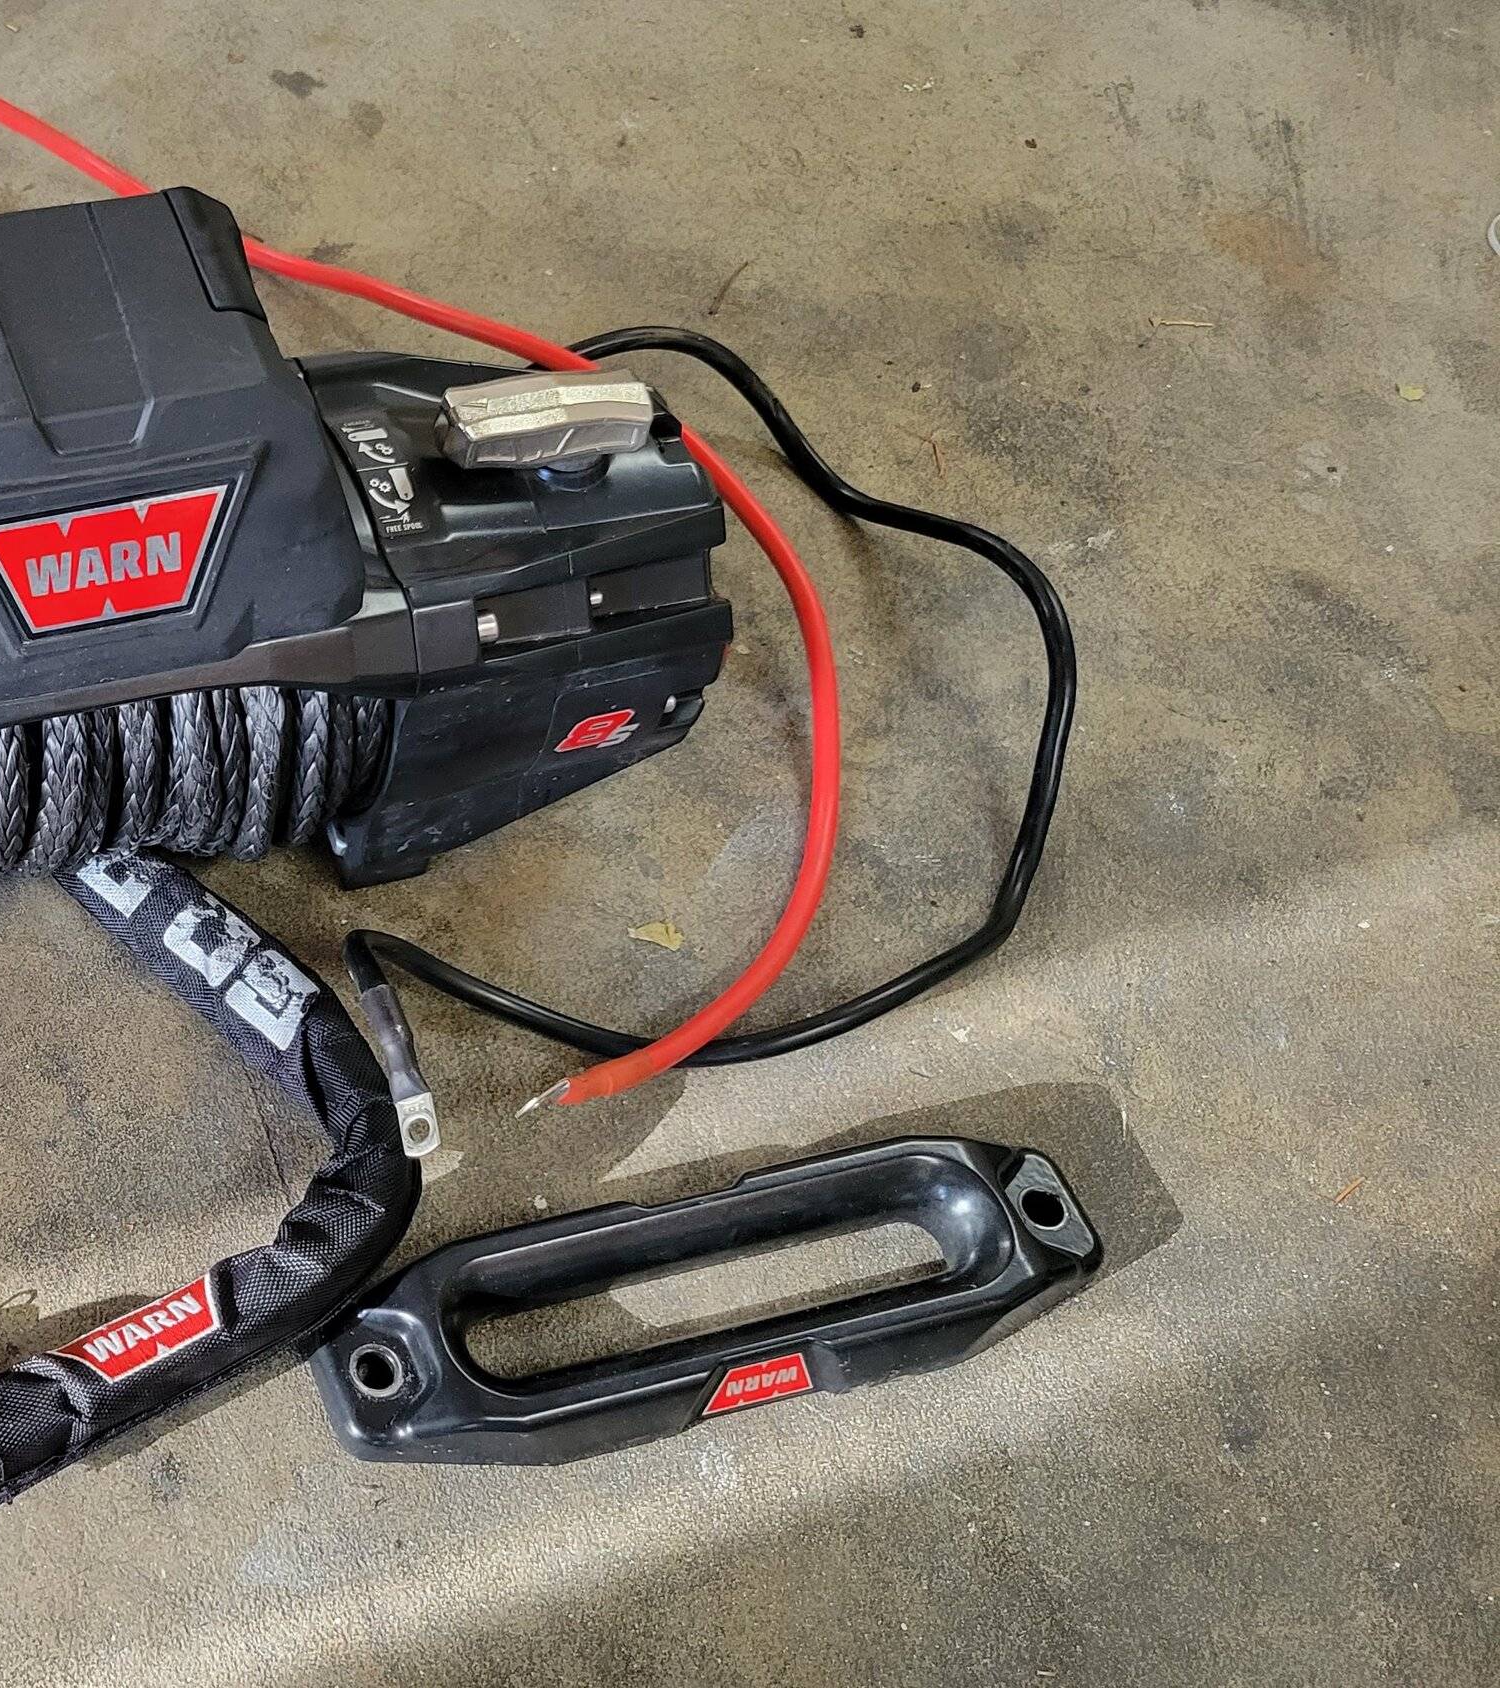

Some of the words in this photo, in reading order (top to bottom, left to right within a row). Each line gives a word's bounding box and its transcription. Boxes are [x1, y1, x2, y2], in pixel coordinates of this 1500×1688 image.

[386, 525, 402, 534] FREE
[24, 531, 183, 598] WARN
[82, 1291, 203, 1364] WARN
[725, 1365, 798, 1398] WARN
